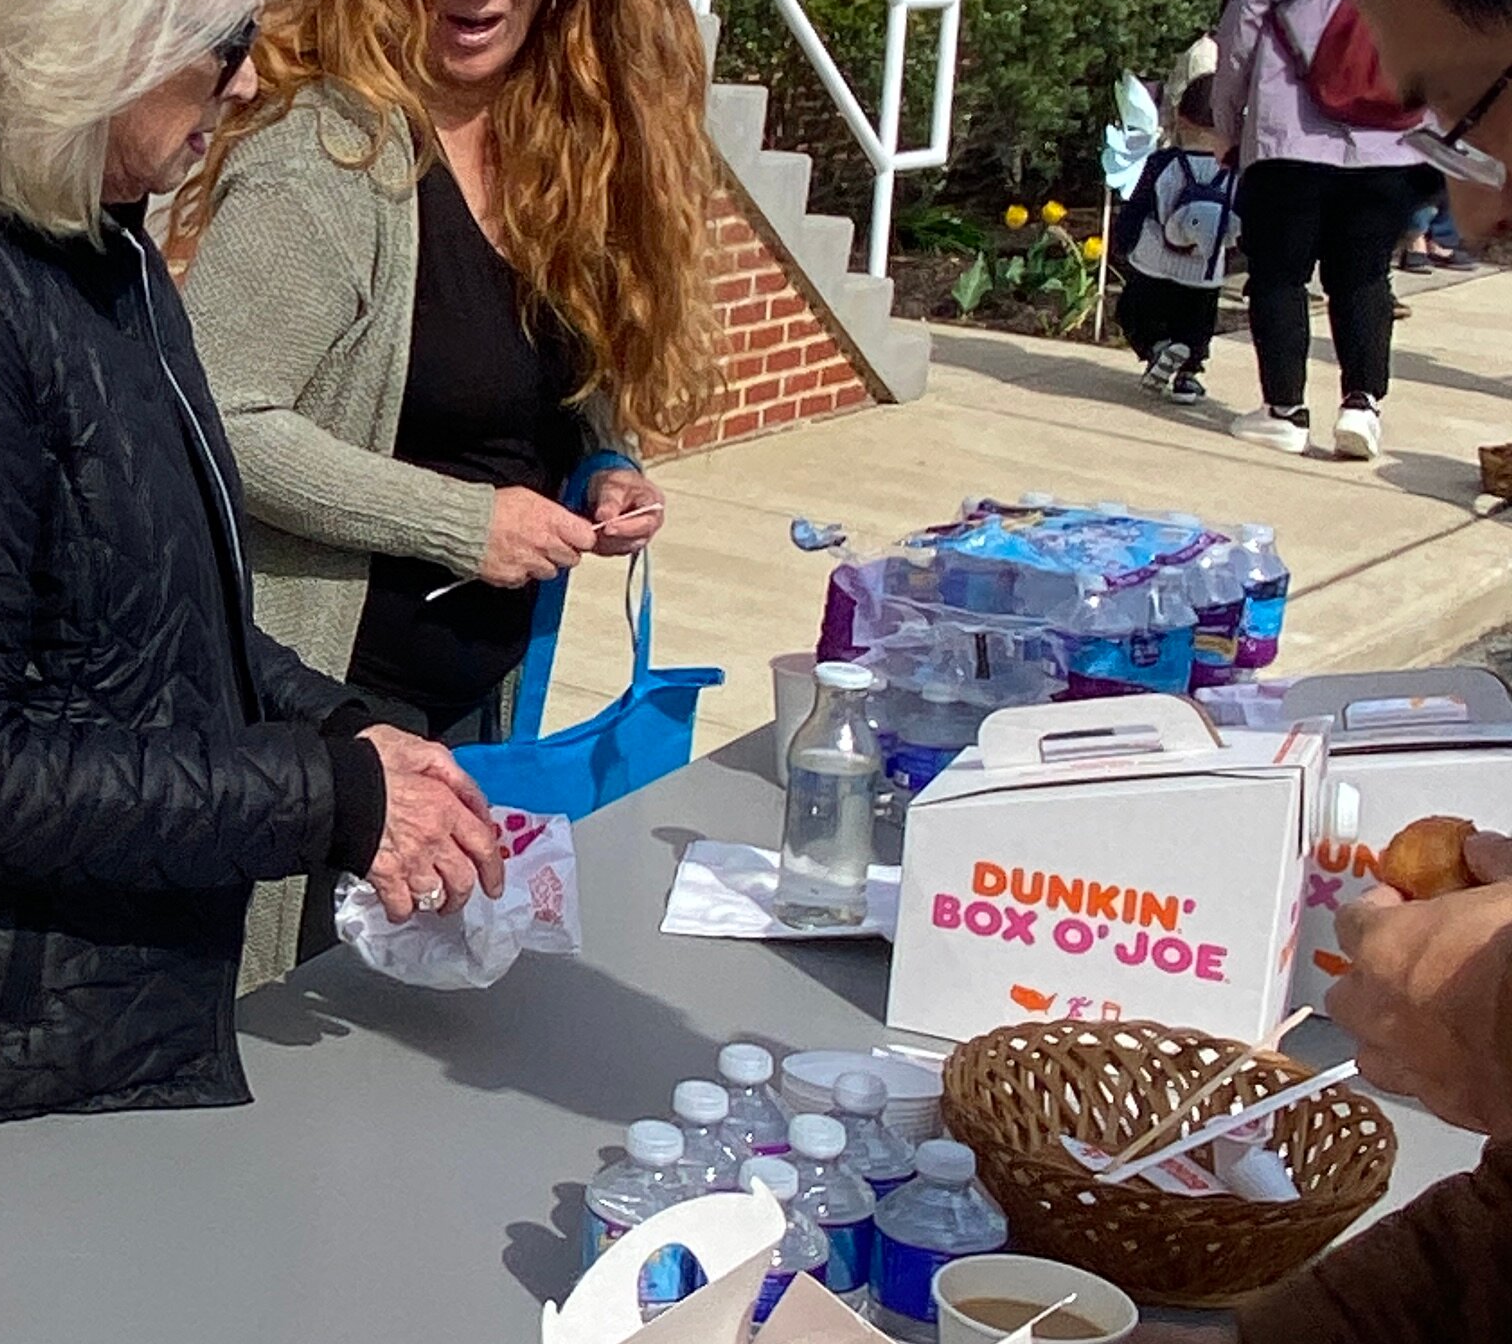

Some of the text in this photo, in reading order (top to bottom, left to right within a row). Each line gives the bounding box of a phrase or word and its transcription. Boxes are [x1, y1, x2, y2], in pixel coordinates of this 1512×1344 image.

[973, 861, 1196, 932] DUNKIN'
[932, 893, 1229, 982] BOX O' JOE
